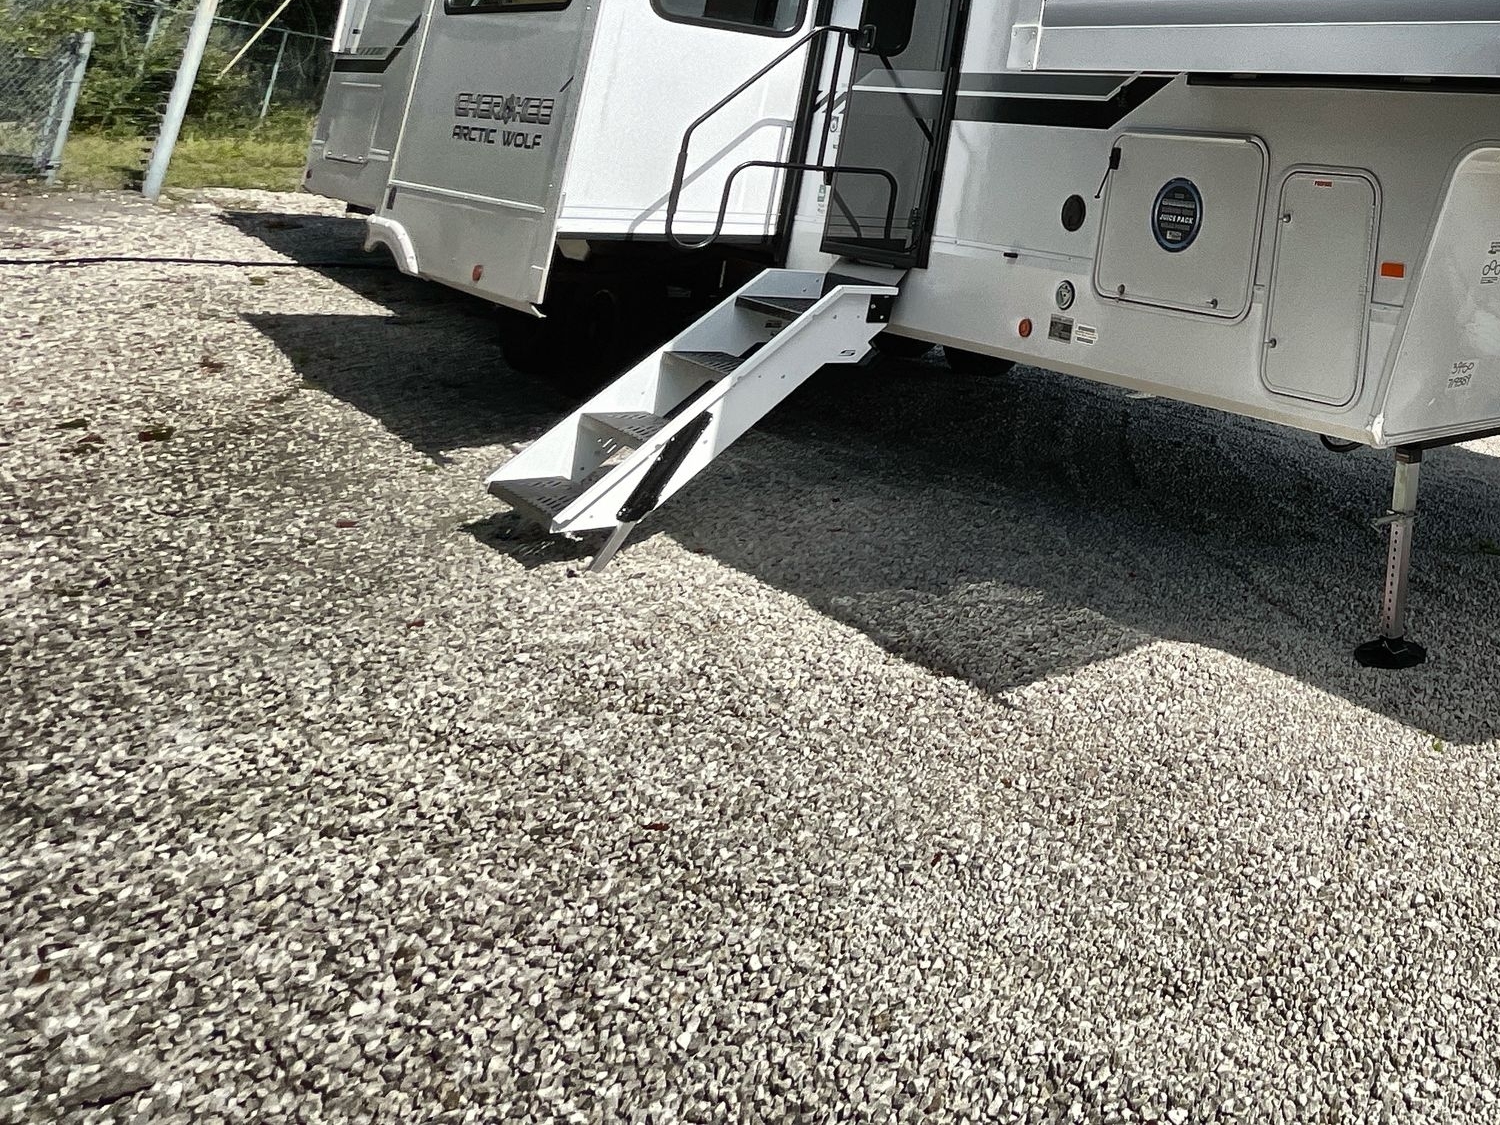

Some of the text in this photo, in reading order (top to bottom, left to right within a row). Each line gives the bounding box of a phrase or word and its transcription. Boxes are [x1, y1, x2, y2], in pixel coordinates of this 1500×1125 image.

[455, 93, 555, 125] CHEROKEE
[452, 125, 542, 150] ARCTIC WOLF
[1159, 214, 1195, 224] JUICE PACK
